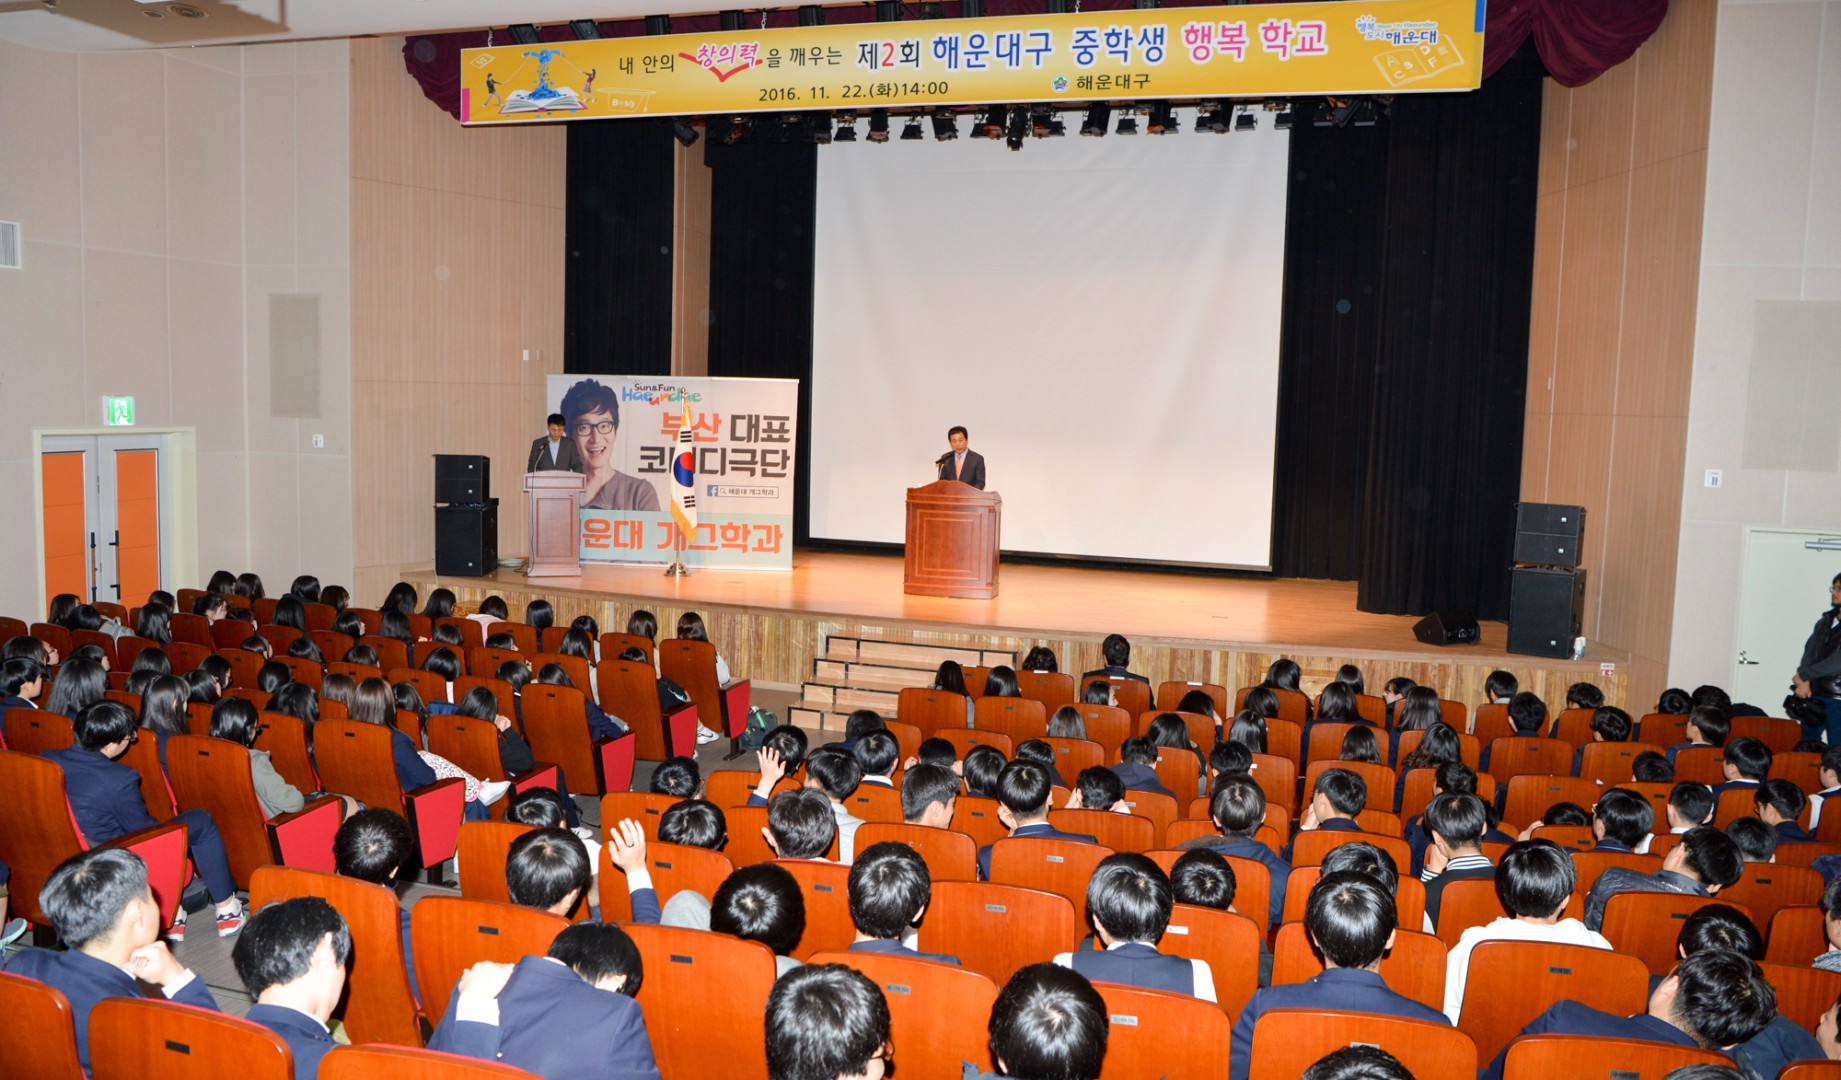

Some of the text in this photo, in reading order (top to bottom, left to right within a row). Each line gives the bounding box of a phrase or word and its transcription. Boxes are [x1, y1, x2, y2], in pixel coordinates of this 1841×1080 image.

[618, 57, 634, 75] 내
[642, 54, 675, 74] 안의
[697, 43, 759, 68] 창의력
[789, 46, 843, 67] 깨우는
[857, 40, 920, 70] 제2회
[932, 31, 1053, 70] 해운대구
[1071, 26, 1165, 66] 중학생
[1184, 24, 1247, 61] 행복
[1261, 21, 1325, 58] 학교
[1385, 30, 1437, 45] 해운대
[759, 87, 801, 102] 2016.
[810, 86, 831, 99] 11.
[1076, 73, 1151, 91] 해운대구
[634, 383, 675, 392] Sun&Fun
[660, 412, 791, 444] 부산 대표
[637, 446, 791, 478] 코디극단
[580, 518, 784, 554] 운대 개그학과
